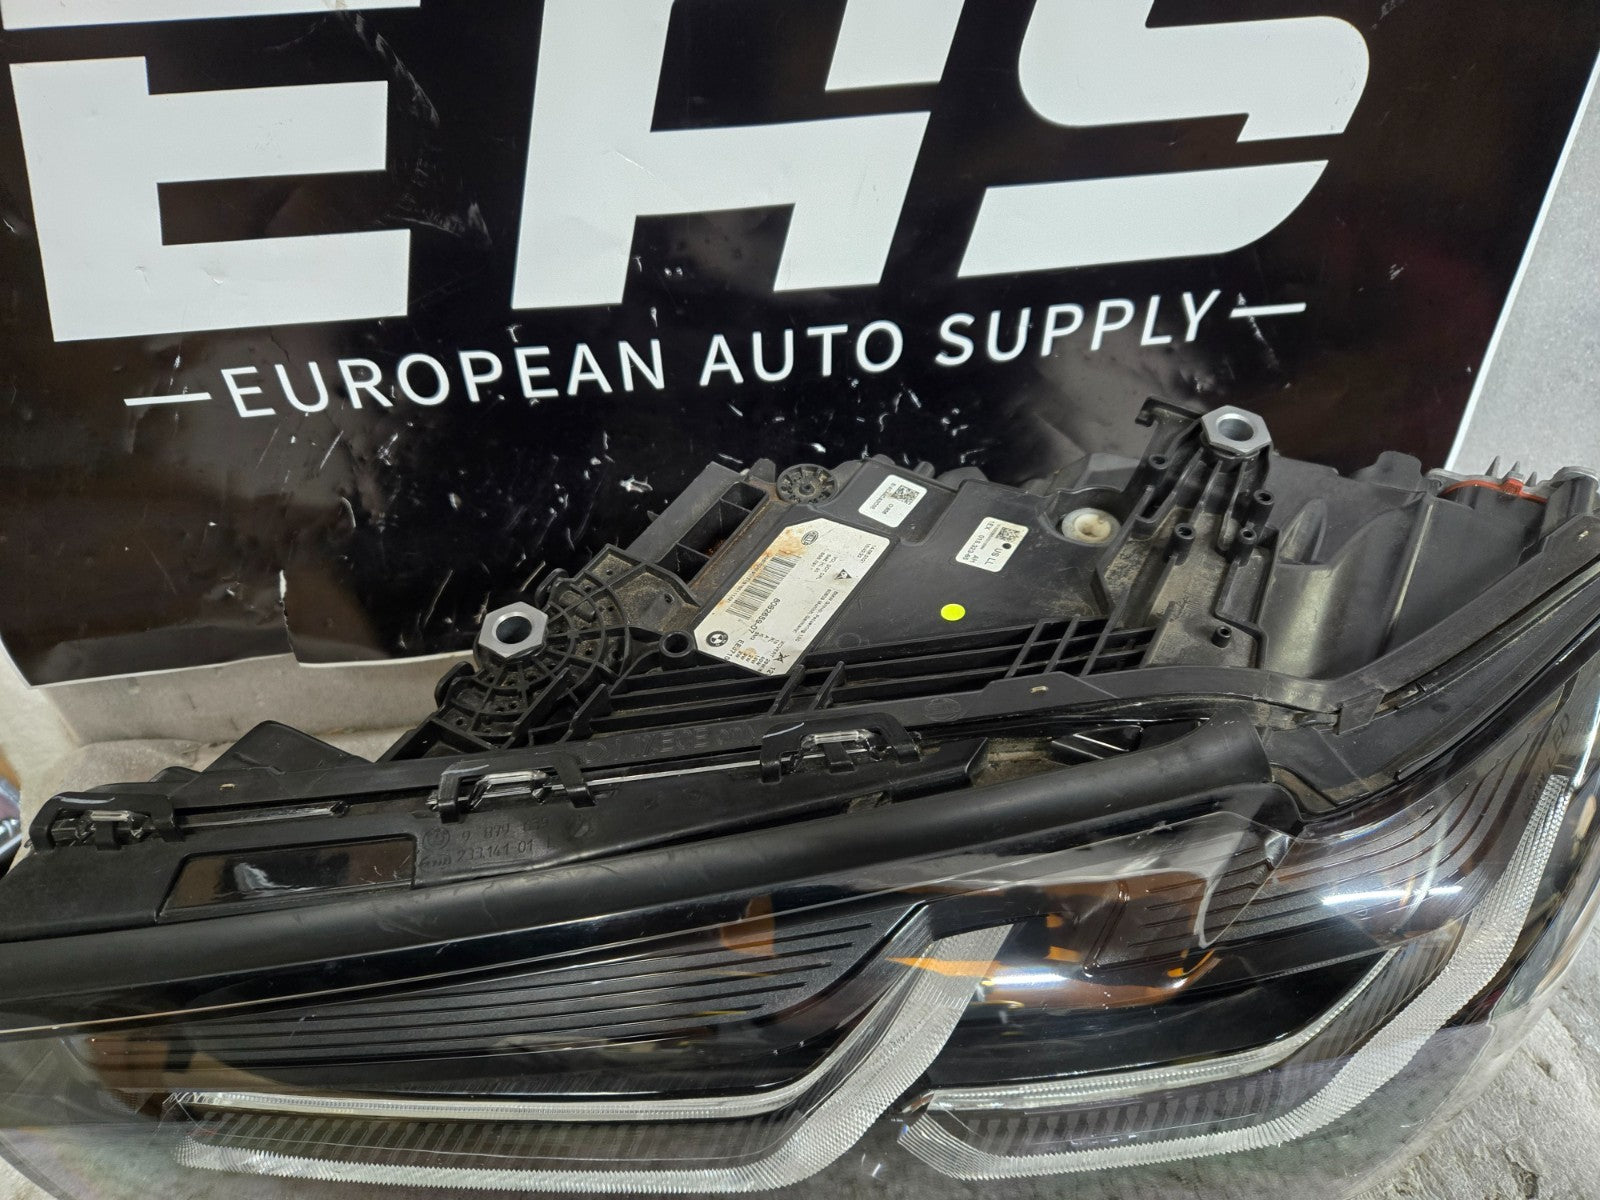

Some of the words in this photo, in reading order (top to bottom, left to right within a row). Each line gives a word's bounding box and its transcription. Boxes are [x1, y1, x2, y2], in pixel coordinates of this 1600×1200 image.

[221, 340, 664, 417] EUROPEAN
[700, 321, 902, 385] AUTO
[936, 290, 1220, 365] SUPPLY
